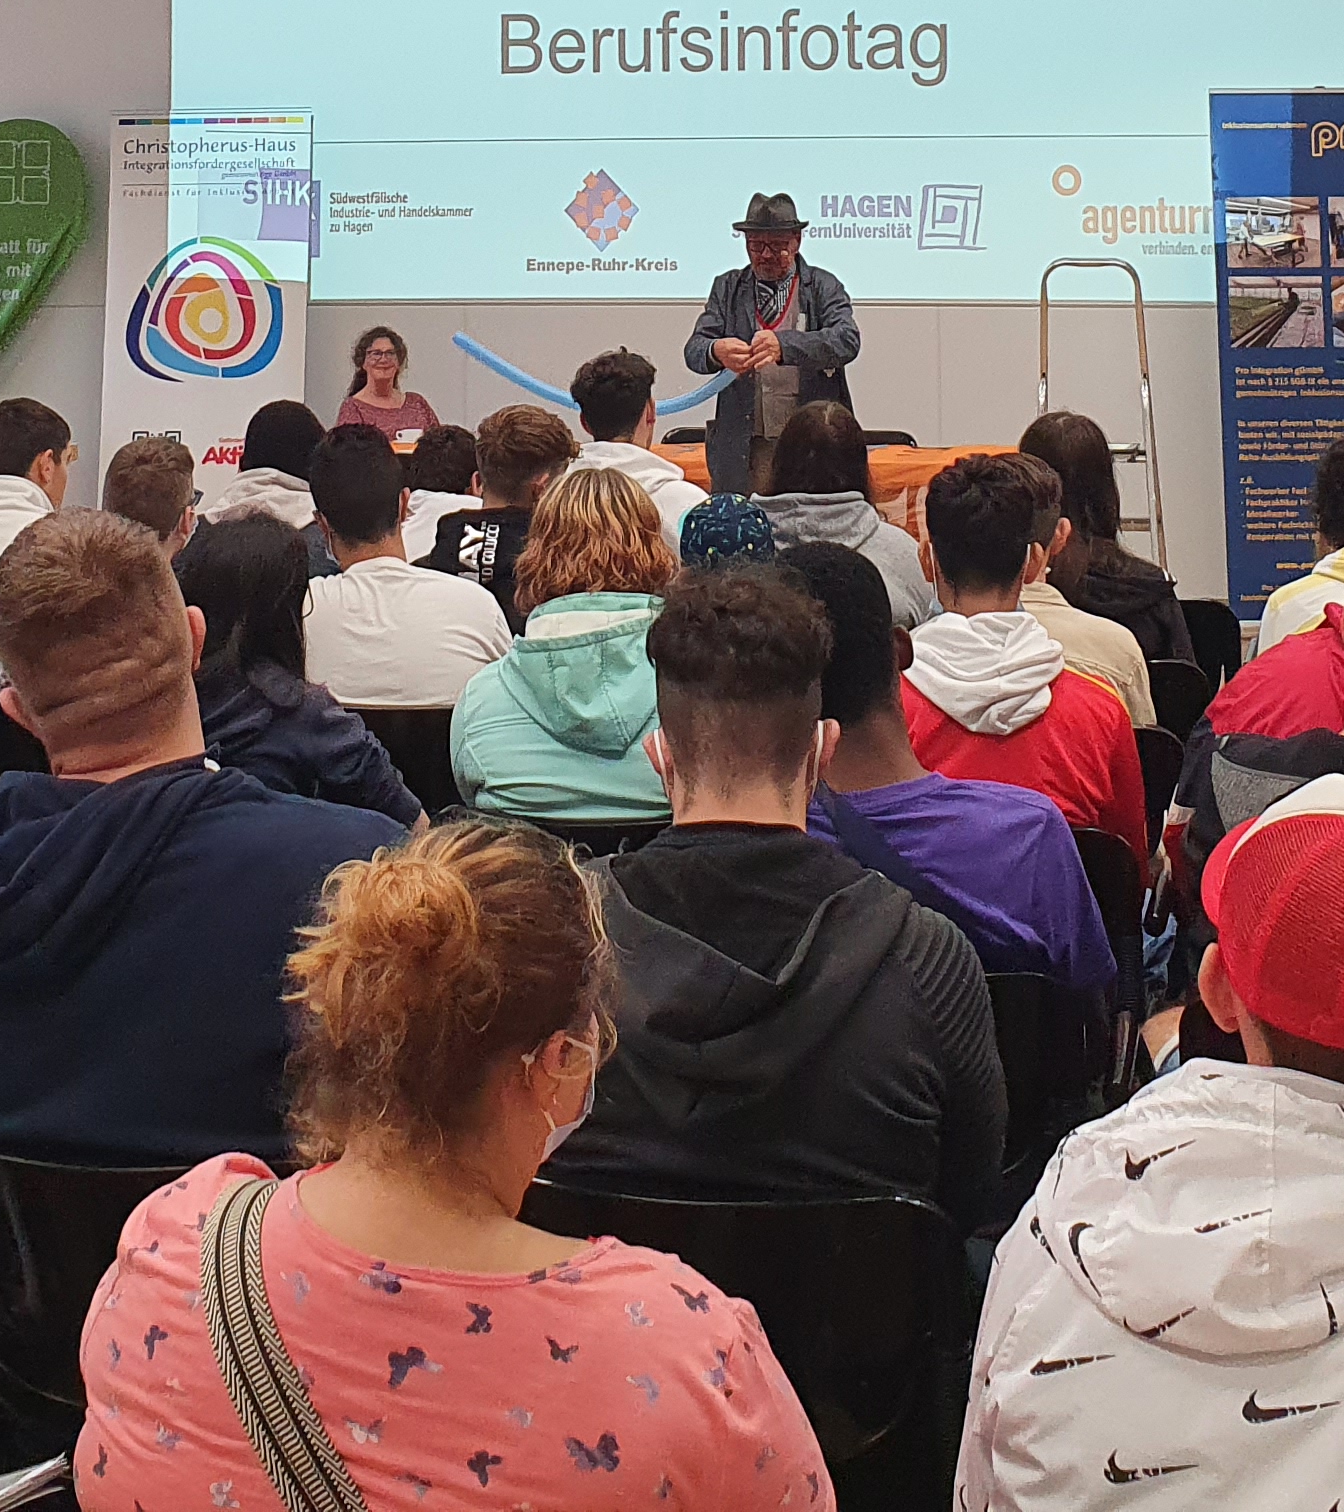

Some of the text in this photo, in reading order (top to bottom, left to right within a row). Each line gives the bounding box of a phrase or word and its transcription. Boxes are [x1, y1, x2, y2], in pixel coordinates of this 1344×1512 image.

[500, 8, 949, 88] Berufsinfotag
[123, 137, 296, 158] Christopherus-Haus
[329, 192, 408, 205] Südwestfälische
[821, 195, 912, 218] HAGEN
[329, 205, 474, 218] Industrie- und Handelskammer
[329, 220, 373, 234] zu Hagen
[27, 238, 50, 254] für
[6, 262, 32, 277] mit
[526, 257, 678, 275] Ennepe-Ruhr-Kreis
[482, 524, 499, 564] COLUCCI
